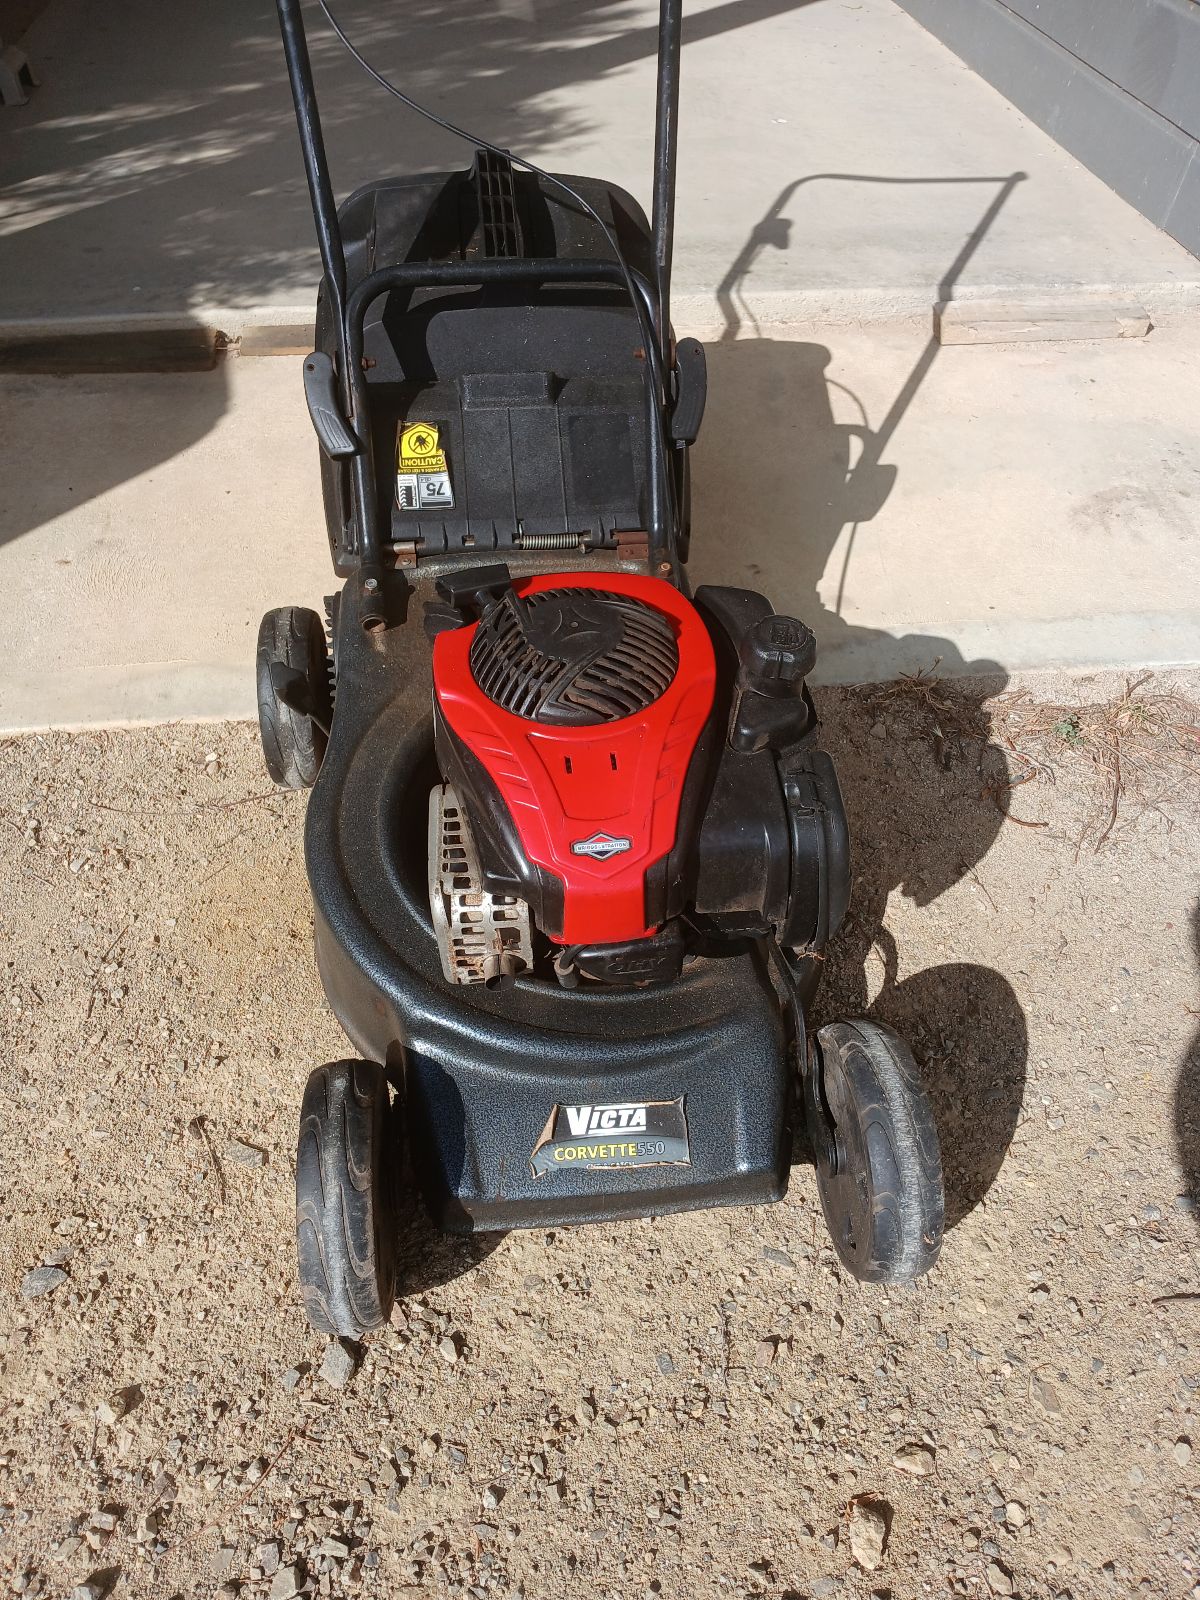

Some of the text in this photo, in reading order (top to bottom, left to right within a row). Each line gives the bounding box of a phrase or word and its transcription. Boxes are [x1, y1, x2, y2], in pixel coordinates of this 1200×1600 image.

[402, 457, 443, 466] CAUTION!
[426, 483, 445, 496] 75
[565, 1105, 647, 1136] VICTA
